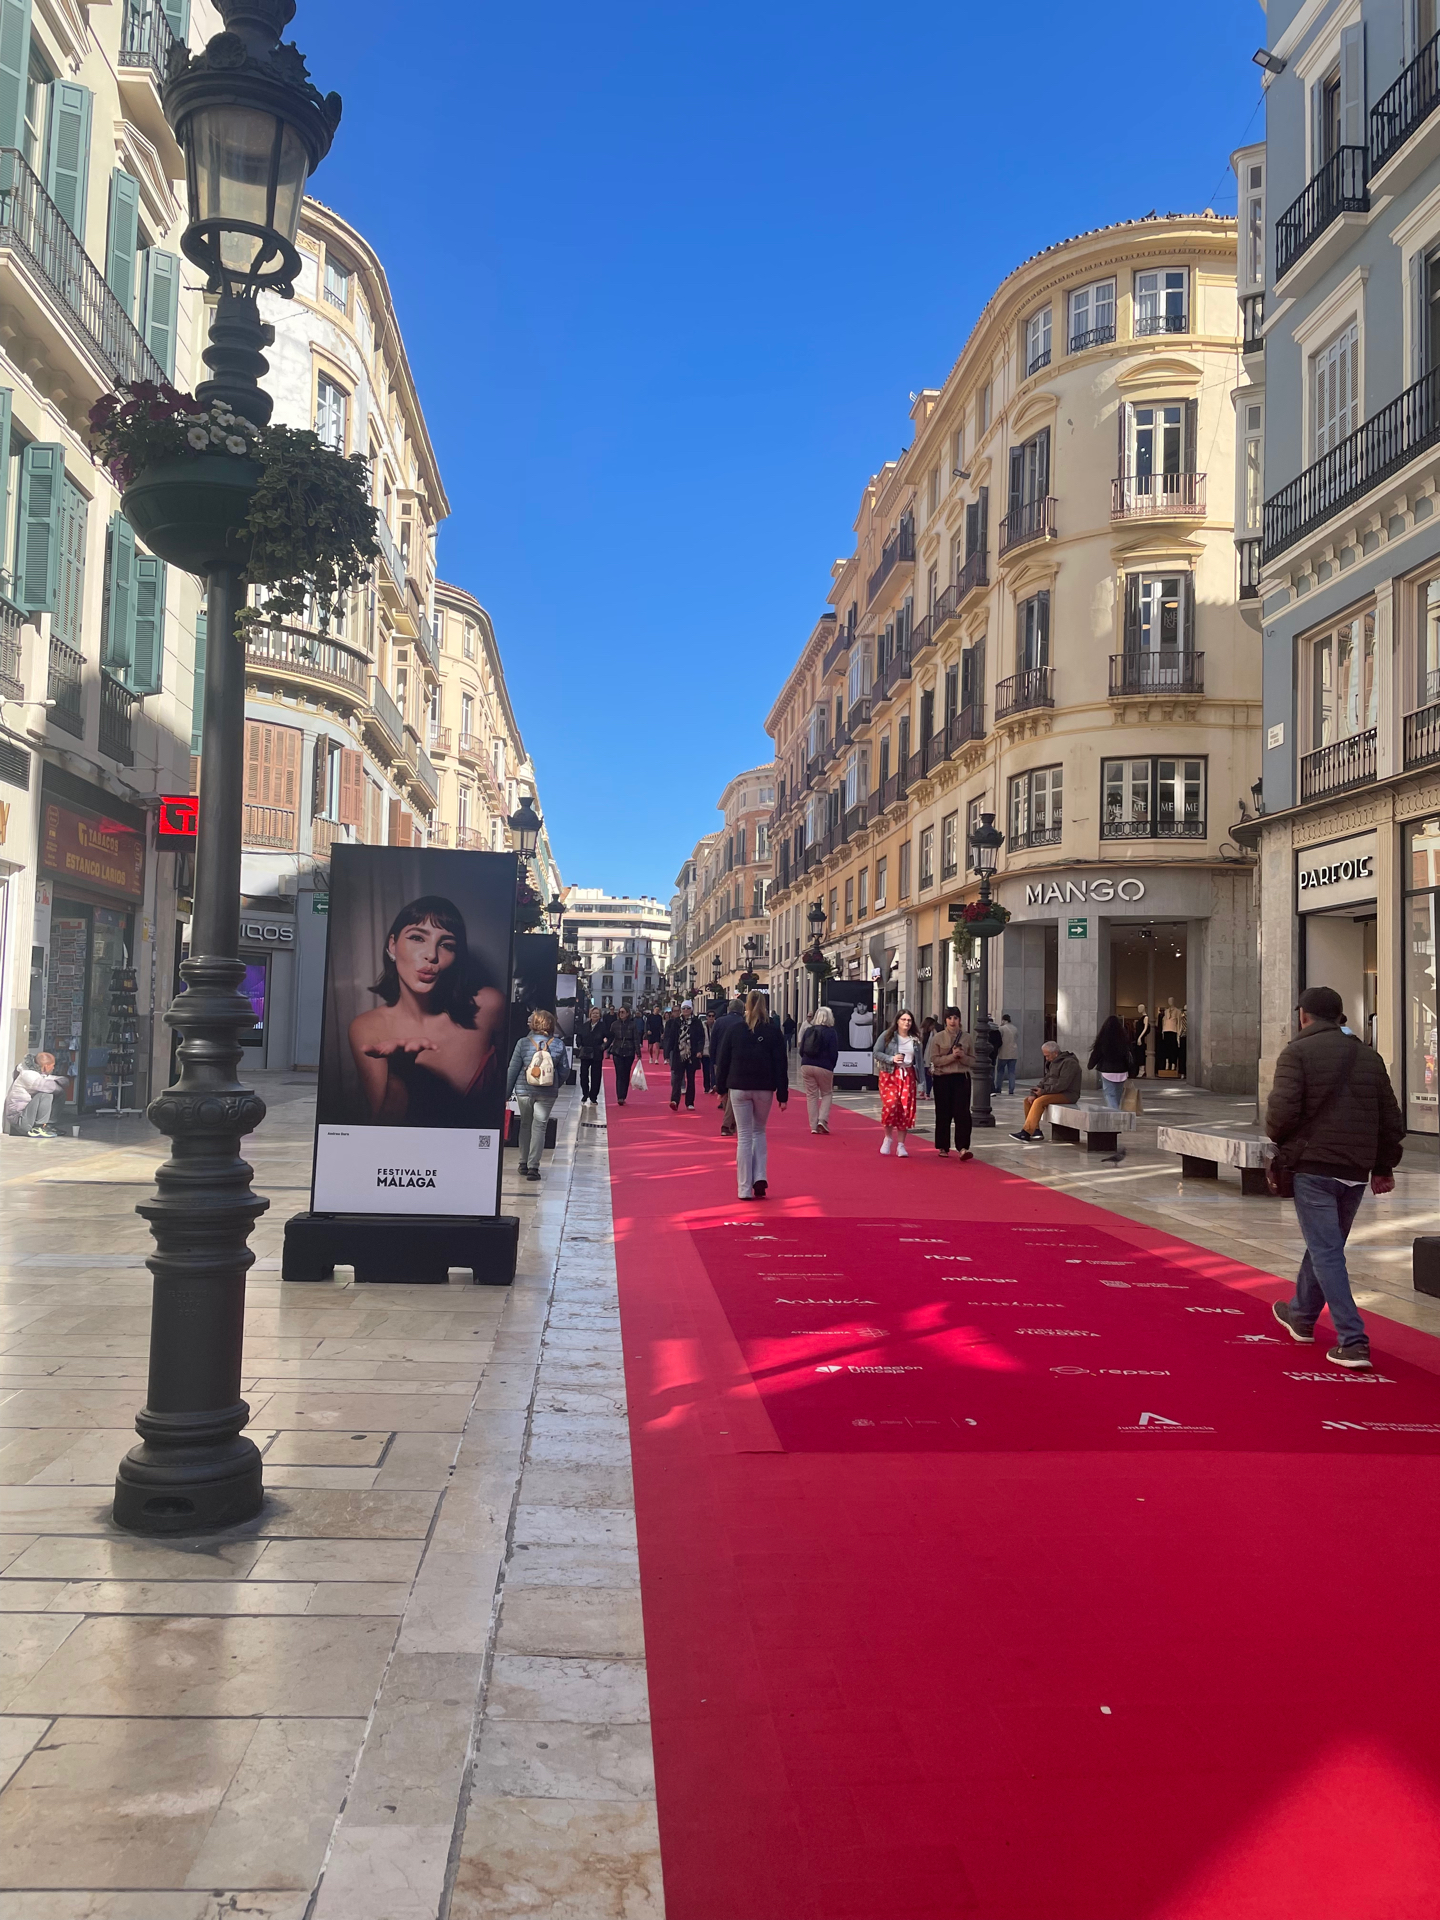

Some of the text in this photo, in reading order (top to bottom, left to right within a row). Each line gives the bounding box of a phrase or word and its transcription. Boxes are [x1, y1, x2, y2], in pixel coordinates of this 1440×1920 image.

[1133, 803, 1147, 812] ME
[1161, 802, 1174, 812] ME
[1186, 803, 1199, 812] ME
[66, 852, 100, 878] ESTANCO
[101, 865, 126, 886] LARIOS
[1299, 856, 1371, 889] PARFOIS
[1026, 878, 1145, 905] MANGO
[240, 923, 294, 941] IQOS
[377, 1168, 437, 1177] FESTIVAL DE
[923, 1254, 973, 1262] rtve
[1184, 1306, 1245, 1315] rtve
[1099, 1368, 1171, 1377] repsol
